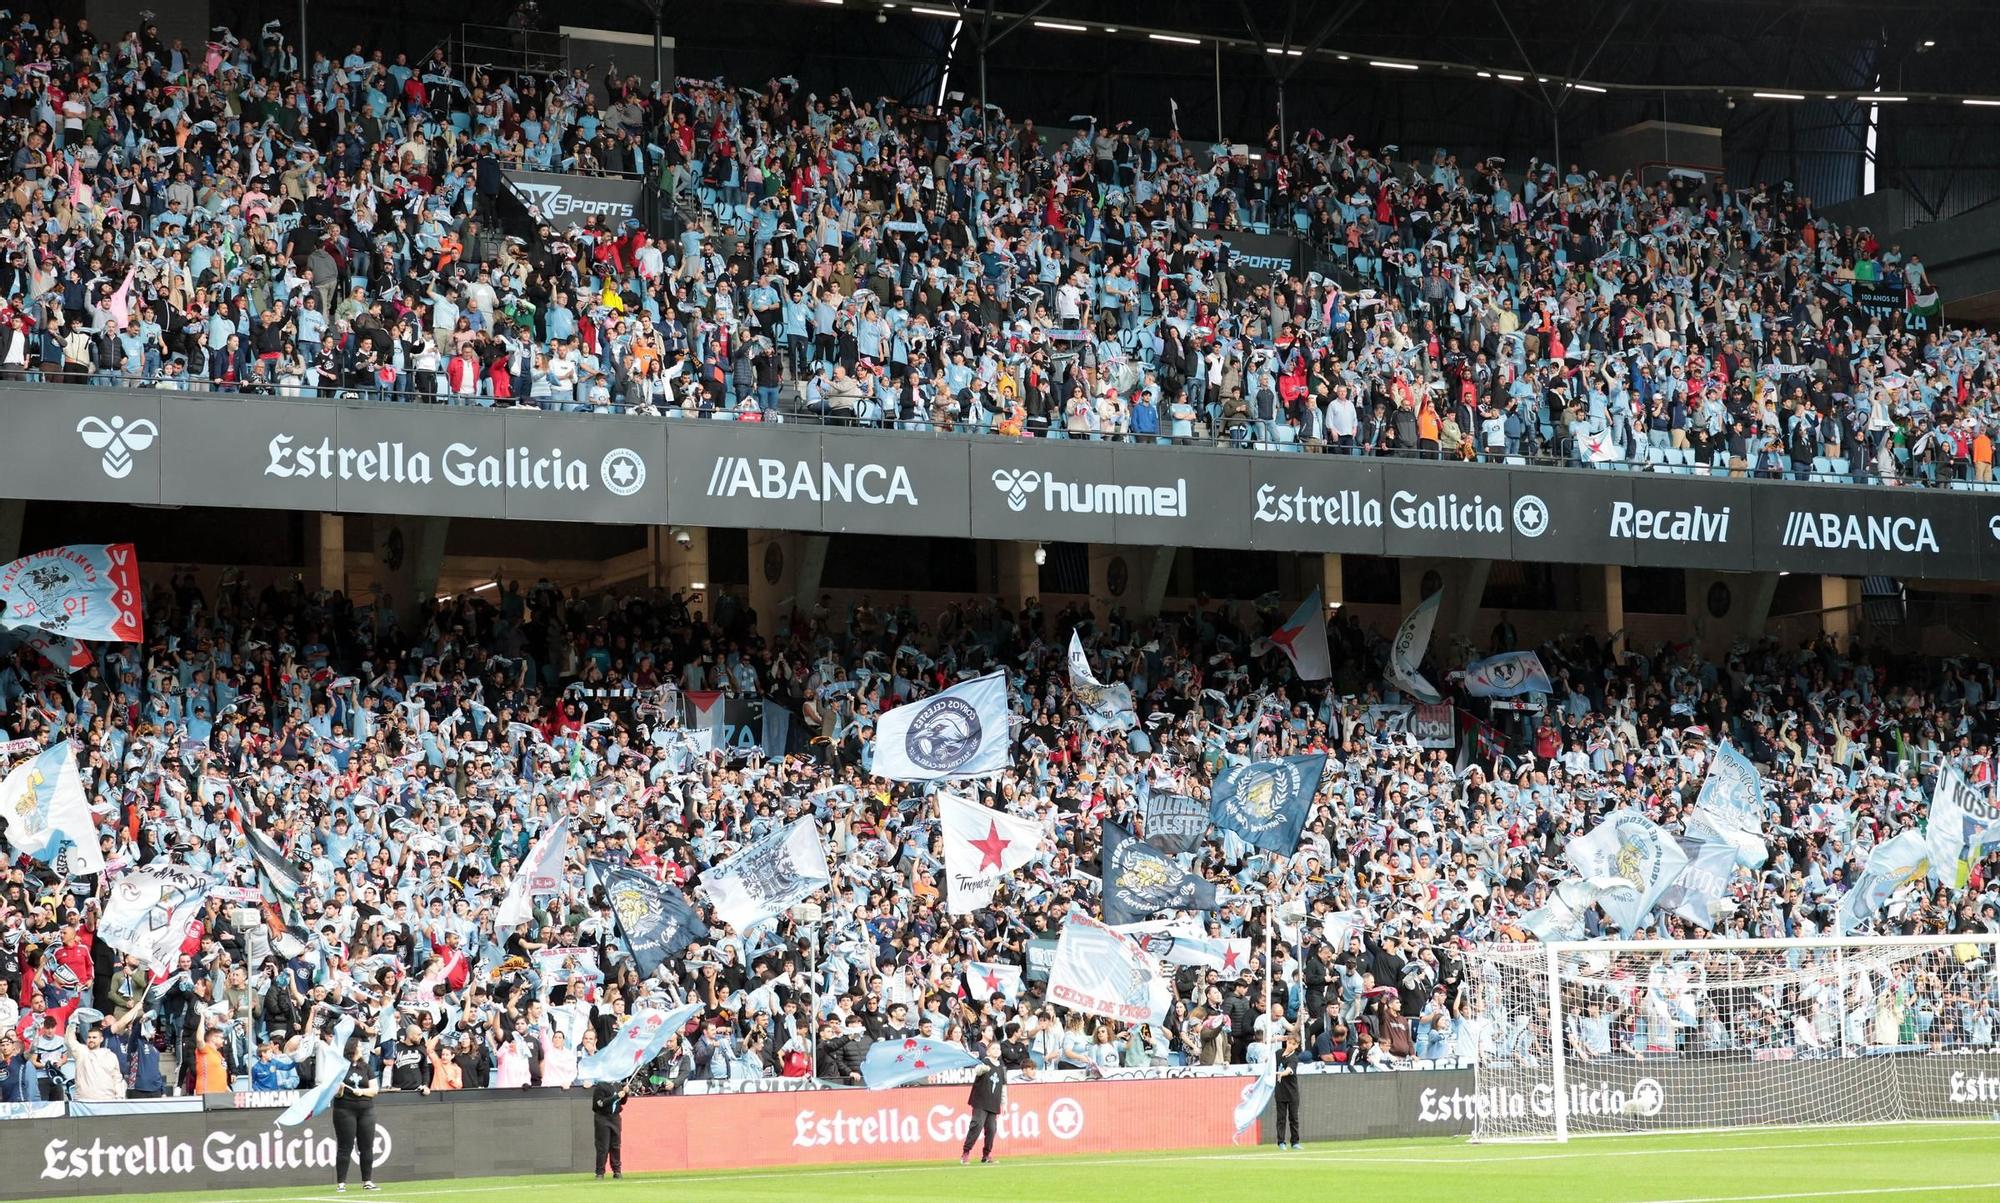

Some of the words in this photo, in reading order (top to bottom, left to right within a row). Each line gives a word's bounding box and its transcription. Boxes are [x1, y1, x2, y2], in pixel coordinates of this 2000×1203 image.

[264, 433, 432, 484] Estrella
[442, 442, 590, 492] Galicia
[1044, 472, 1187, 517] hummel
[1254, 483, 1383, 527] Estrella
[1390, 490, 1504, 533] Galicia
[1610, 502, 1730, 543] Recalvi
[1098, 1000, 1114, 1014] DE
[1418, 1087, 1526, 1122] Estrella
[1530, 1081, 1625, 1118] Glicia
[792, 1108, 920, 1147] Estrella
[927, 1102, 1040, 1143] Gacia
[40, 1135, 195, 1180] Estrella
[202, 1128, 337, 1173] Galicia
